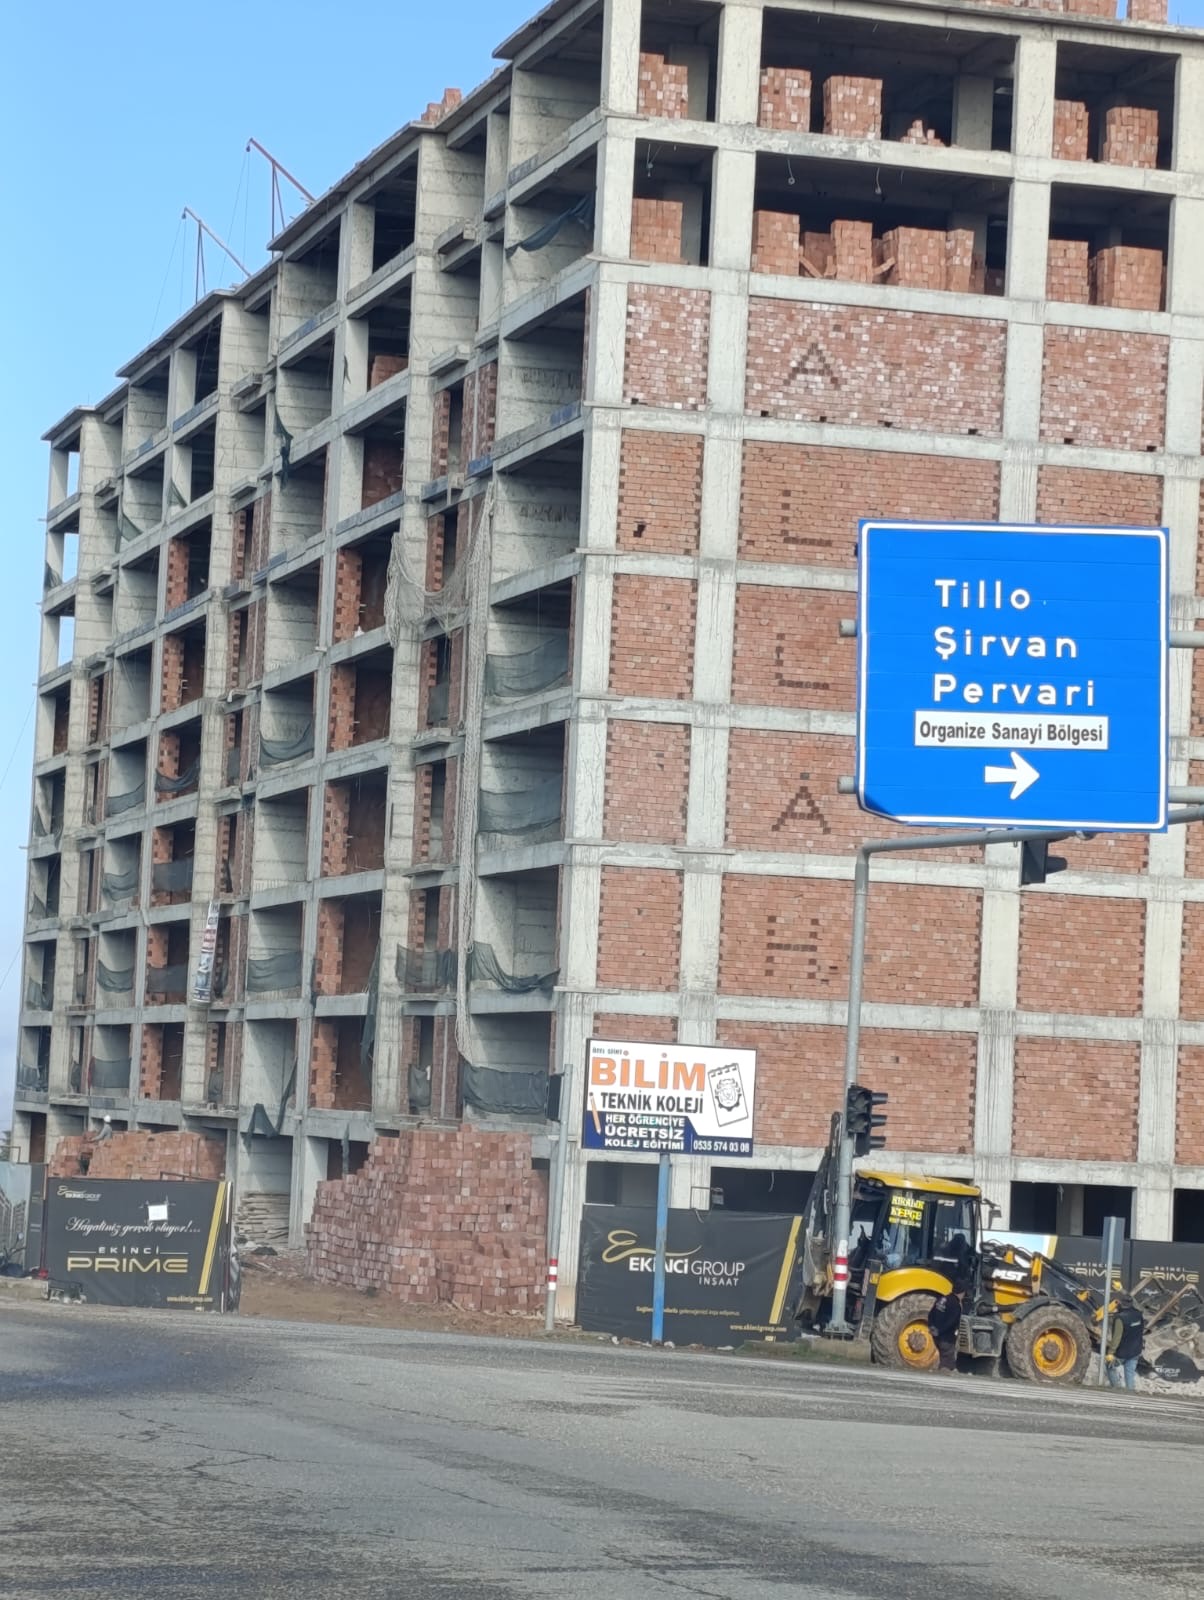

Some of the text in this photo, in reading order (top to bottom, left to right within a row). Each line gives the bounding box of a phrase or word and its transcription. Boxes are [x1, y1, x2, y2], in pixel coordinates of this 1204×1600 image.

[934, 579, 1031, 610] Tillo
[934, 626, 1077, 660] Şirvan
[933, 673, 1094, 706] Pervari
[920, 721, 1103, 746] Organize Sanayi Bölgesi
[590, 1050, 706, 1092] BİLİM
[601, 1090, 703, 1114] TEKNİK KOLEJİ
[605, 1113, 626, 1125] HER
[605, 1125, 685, 1140] ÜCRETSİZ
[604, 1138, 640, 1148] KOLEJ
[693, 1140, 712, 1151] 0535
[713, 1141, 728, 1152] 574
[67, 1257, 188, 1273] PRIME
[690, 1260, 746, 1277] GROUP
